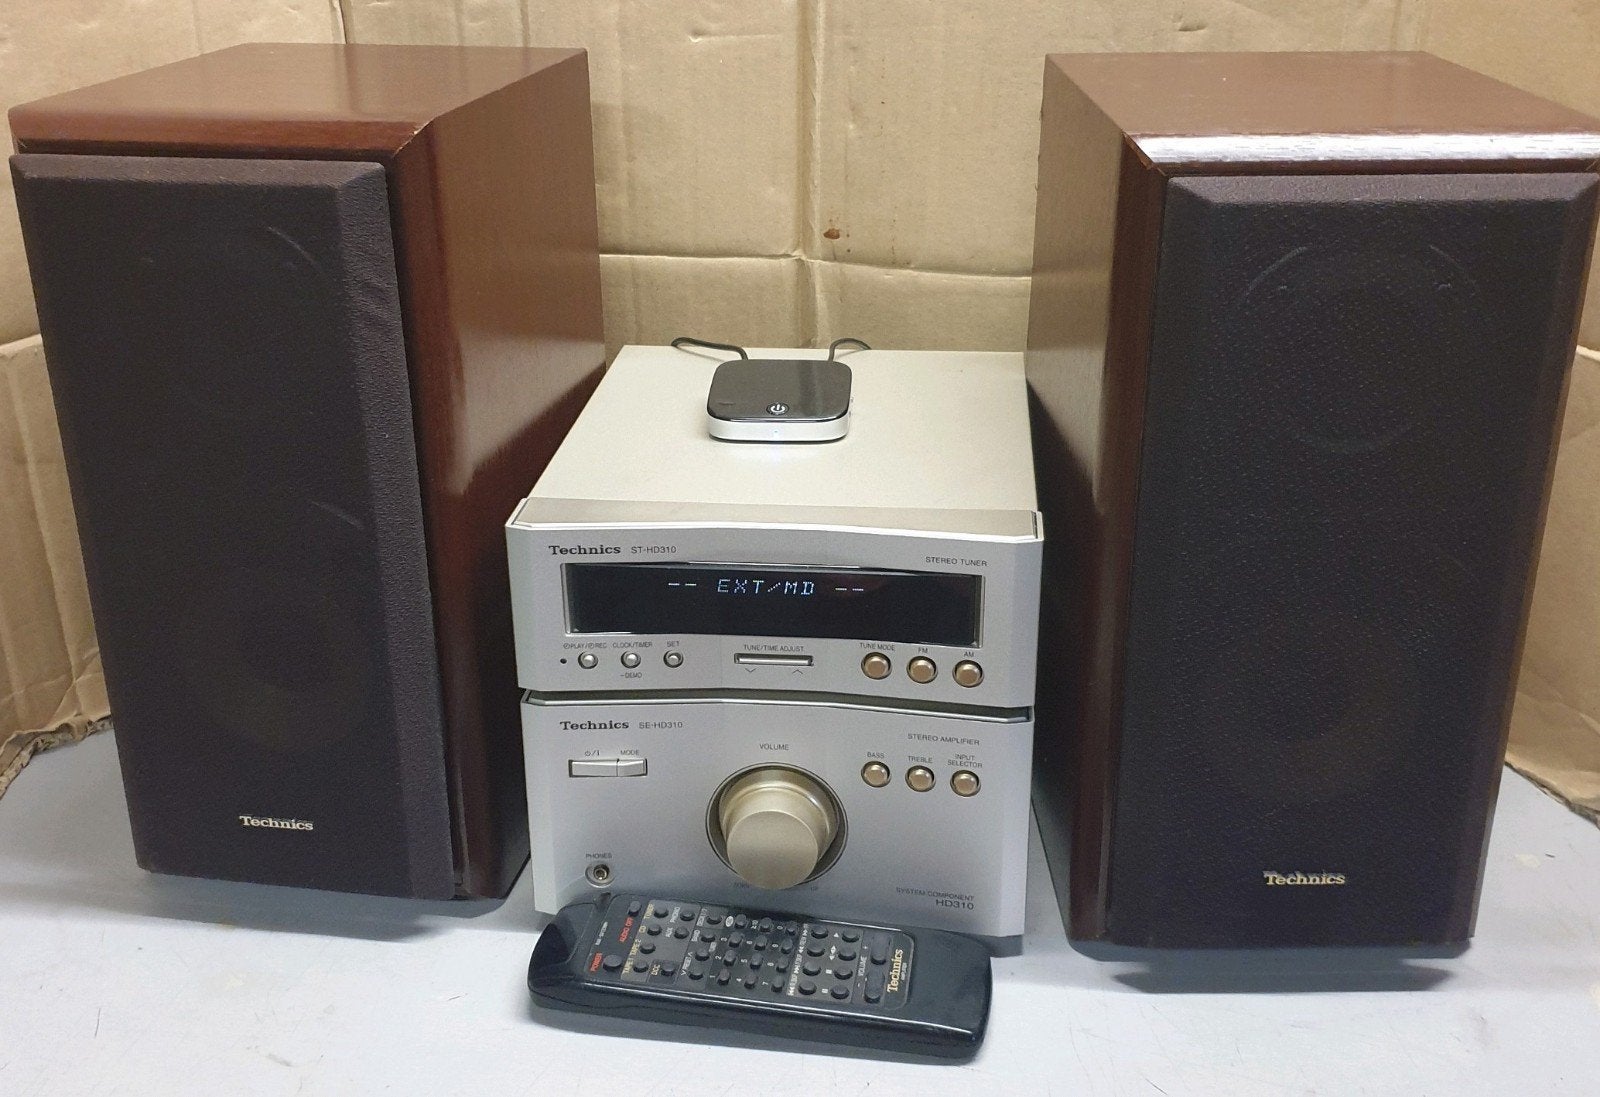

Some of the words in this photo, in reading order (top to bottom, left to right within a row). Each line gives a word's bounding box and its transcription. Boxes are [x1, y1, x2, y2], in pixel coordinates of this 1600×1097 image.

[548, 545, 621, 556] Technics
[631, 546, 677, 554] ST-HD310
[925, 556, 958, 565] STEREO
[961, 558, 988, 567] TUNER
[717, 578, 815, 596] EXT/MD
[612, 641, 653, 649] CLOCK/TIMER
[667, 640, 680, 648] SET
[744, 644, 779, 652] TUNE/TIME
[780, 645, 805, 653] ADJUST
[860, 642, 876, 650] TUNE
[559, 720, 629, 731] Technics
[639, 721, 683, 729] SE-HD310
[907, 732, 939, 742] STEREO
[940, 736, 980, 746] AMPLIFIER
[759, 743, 790, 751] VOLUME
[867, 751, 885, 759] BASS
[908, 755, 933, 764] TREBLE
[947, 759, 983, 768] SELECTOR
[239, 815, 314, 831] Technics
[585, 852, 612, 860] PHONES
[1262, 870, 1346, 885] Technics
[896, 886, 926, 896] SYSTEM
[927, 890, 975, 901] COMPONENT
[935, 899, 974, 910] HD310
[886, 948, 904, 993] Technics
